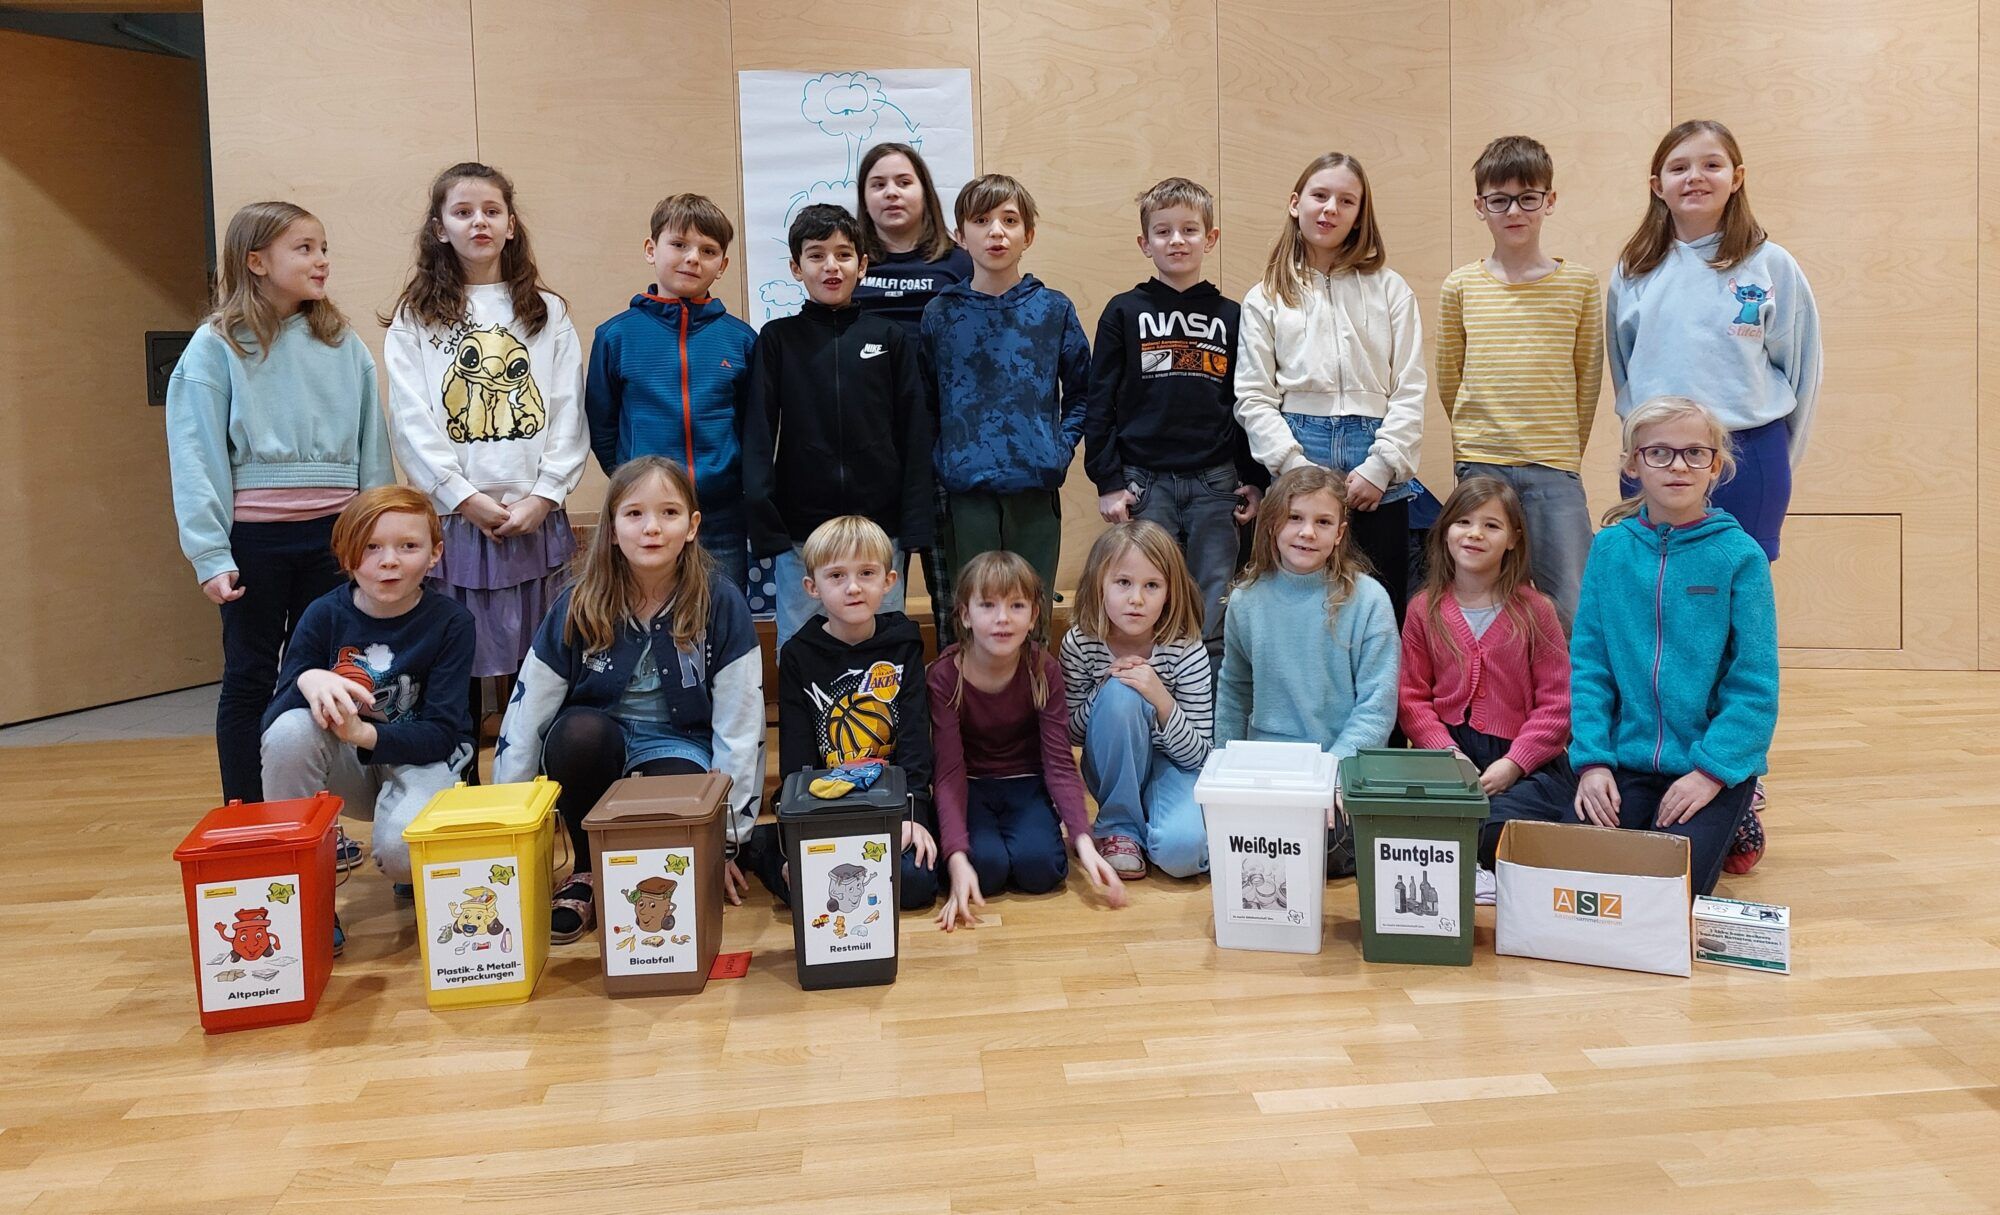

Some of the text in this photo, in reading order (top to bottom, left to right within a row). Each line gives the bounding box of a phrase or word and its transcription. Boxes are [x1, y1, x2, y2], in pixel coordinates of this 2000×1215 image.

[859, 276, 934, 291] AMALFI COAST
[1138, 310, 1228, 346] NASA
[1727, 325, 1763, 338] Stitch
[444, 319, 483, 356] Stitch
[863, 343, 883, 353] NIKE
[864, 672, 902, 692] LAKER
[1229, 836, 1301, 858] Weißglas
[1380, 843, 1454, 866] Buntglas
[1555, 890, 1620, 917] ASZ
[830, 943, 871, 953] Restmüll
[630, 956, 675, 966] Bioabfall
[437, 961, 521, 977] Plastik- & Metall-
[445, 970, 515, 983] verpackungen
[228, 988, 281, 1001] Altpapier
